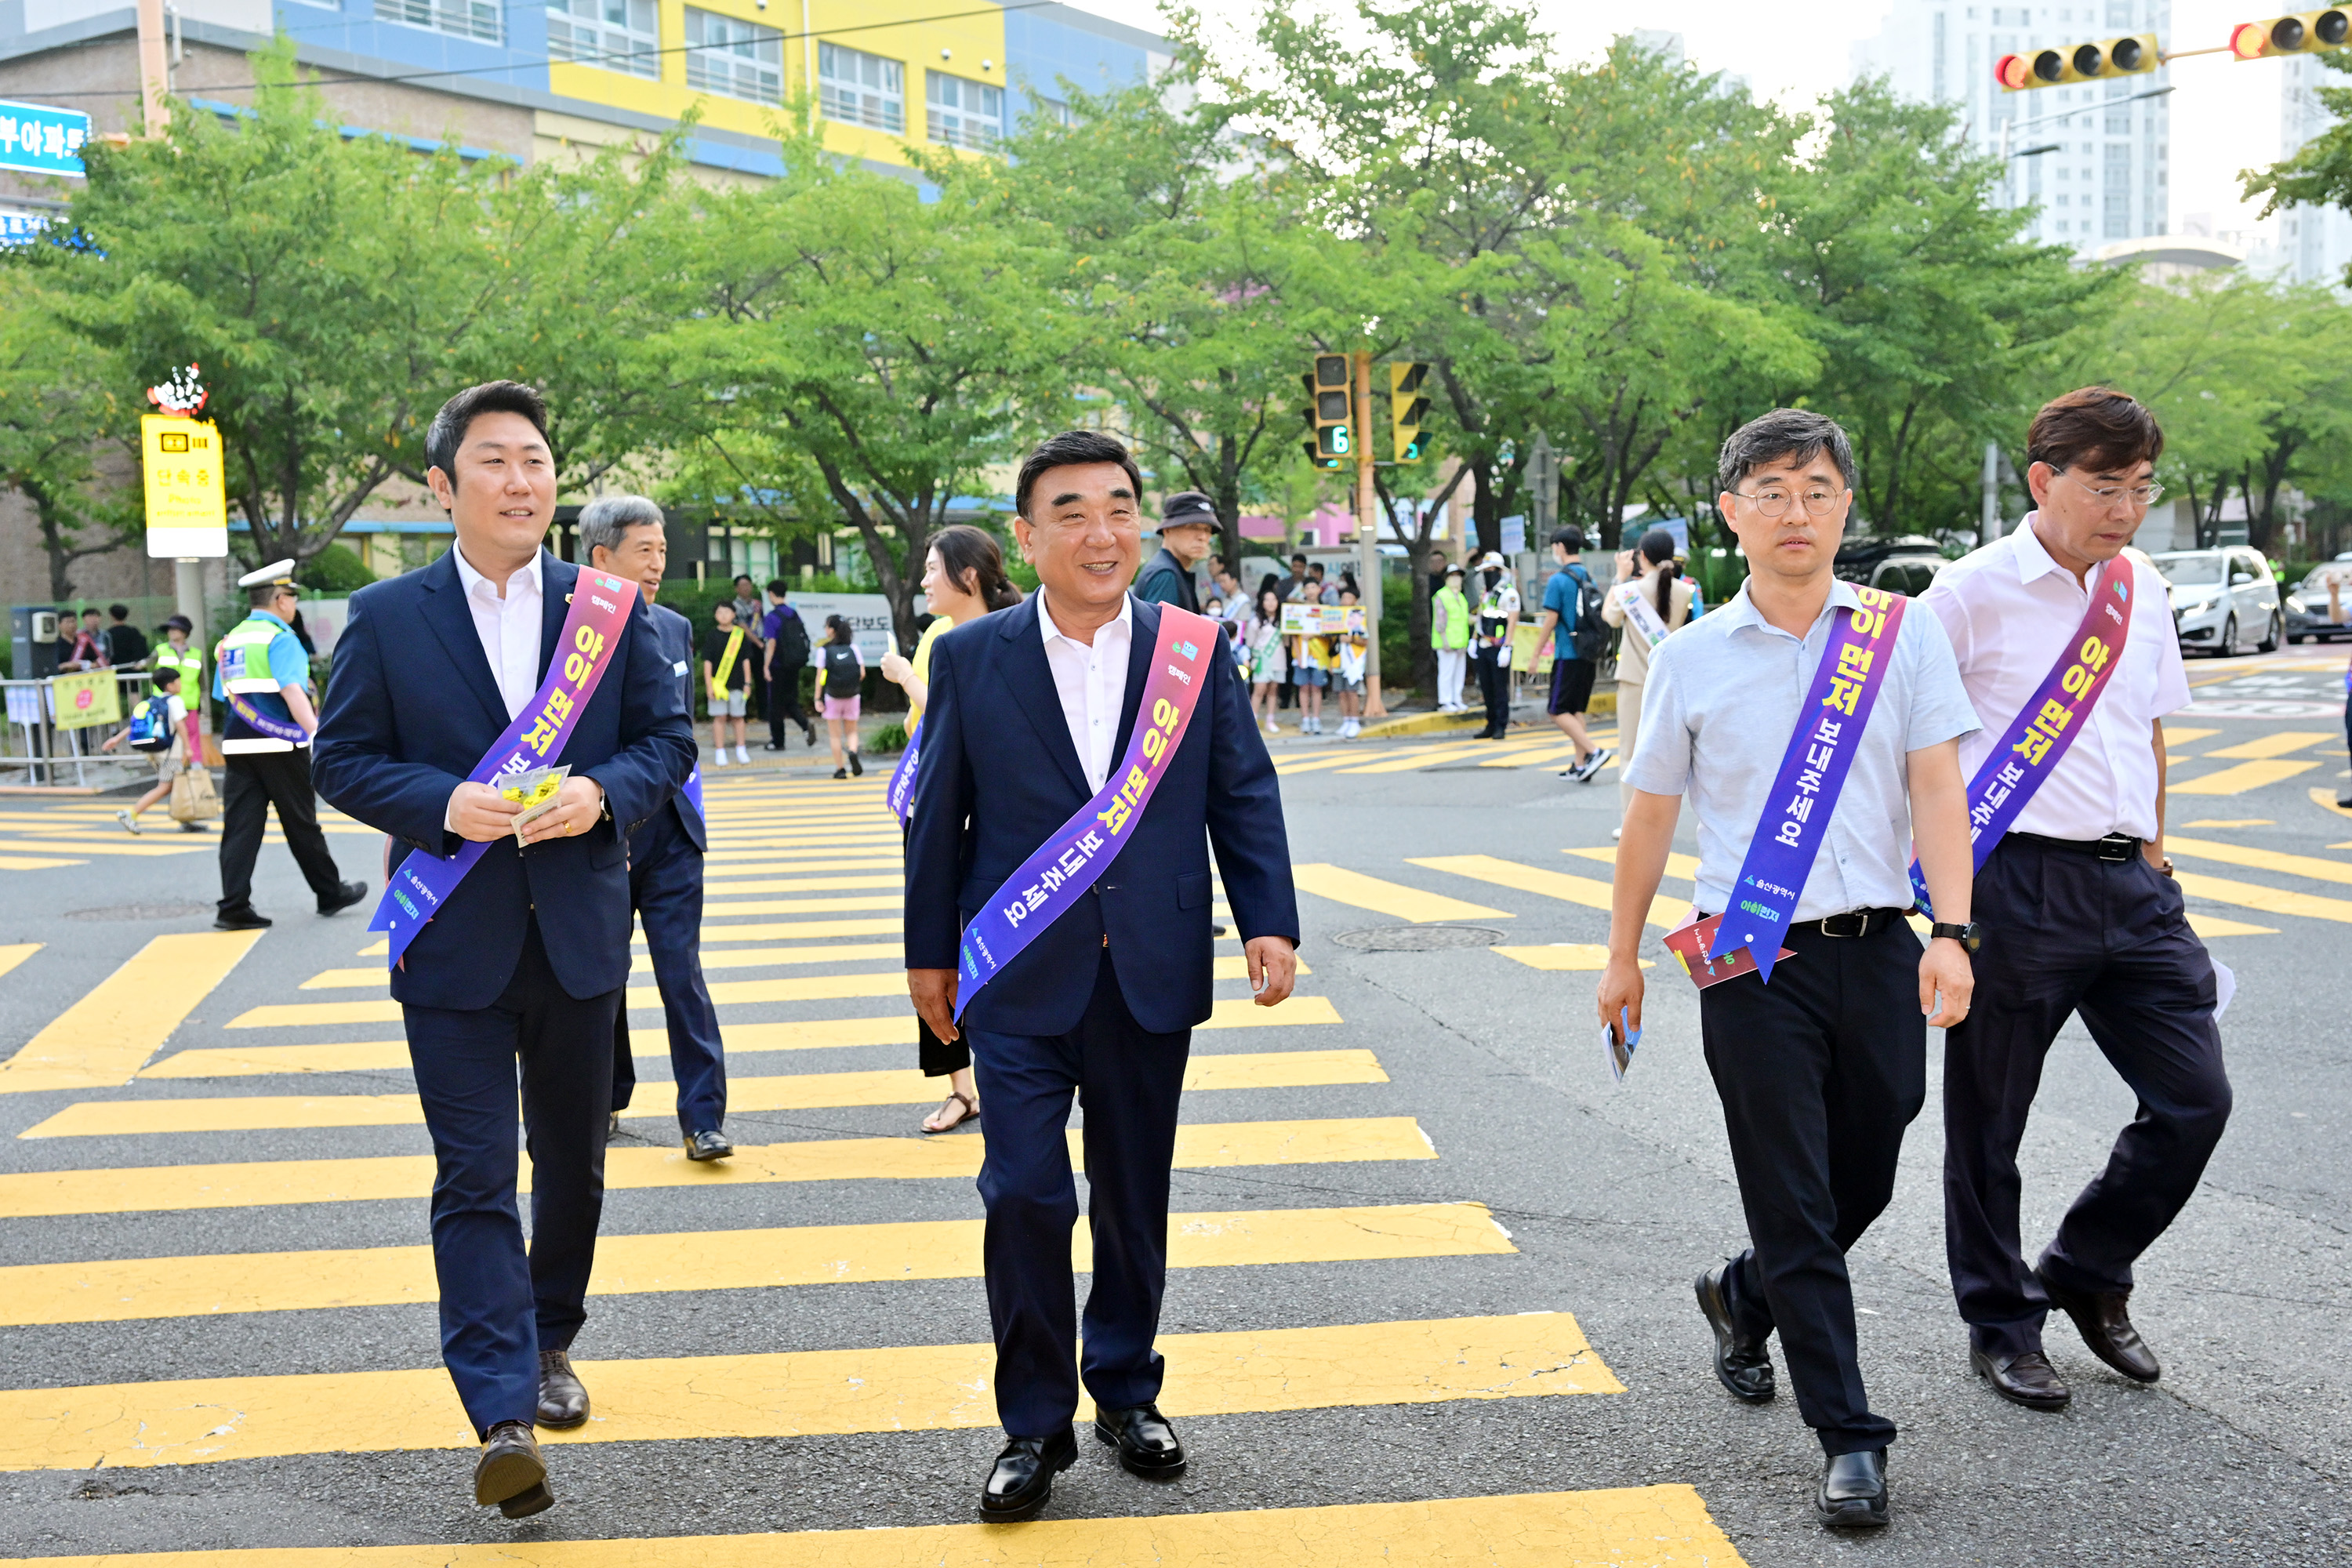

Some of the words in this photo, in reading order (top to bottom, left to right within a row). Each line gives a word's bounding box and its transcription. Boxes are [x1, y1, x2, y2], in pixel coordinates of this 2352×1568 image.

[1332, 426, 1349, 454] 6
[591, 595, 616, 614] 캠페인
[1850, 588, 1893, 639] 아이
[2105, 603, 2123, 626] 캠페인
[564, 625, 604, 691] 아이
[1167, 664, 1191, 686] 캠페인
[1821, 642, 1875, 717] 먼저
[2062, 636, 2110, 702] 아이
[521, 687, 575, 757] 먼저
[1142, 698, 1180, 768] 아이
[2013, 698, 2074, 766] 먼저
[1097, 764, 1149, 836] 먼저
[1774, 717, 1842, 848] 보내주세요
[410, 876, 438, 906] 울산광역시
[1004, 829, 1105, 928] 보내주세요
[1756, 879, 1795, 900] 울산광역시
[394, 889, 419, 920] 아이먼저
[1740, 899, 1780, 923] 아이먼저
[963, 945, 979, 980] 아이먼저
[975, 936, 996, 970] 울산광역시
